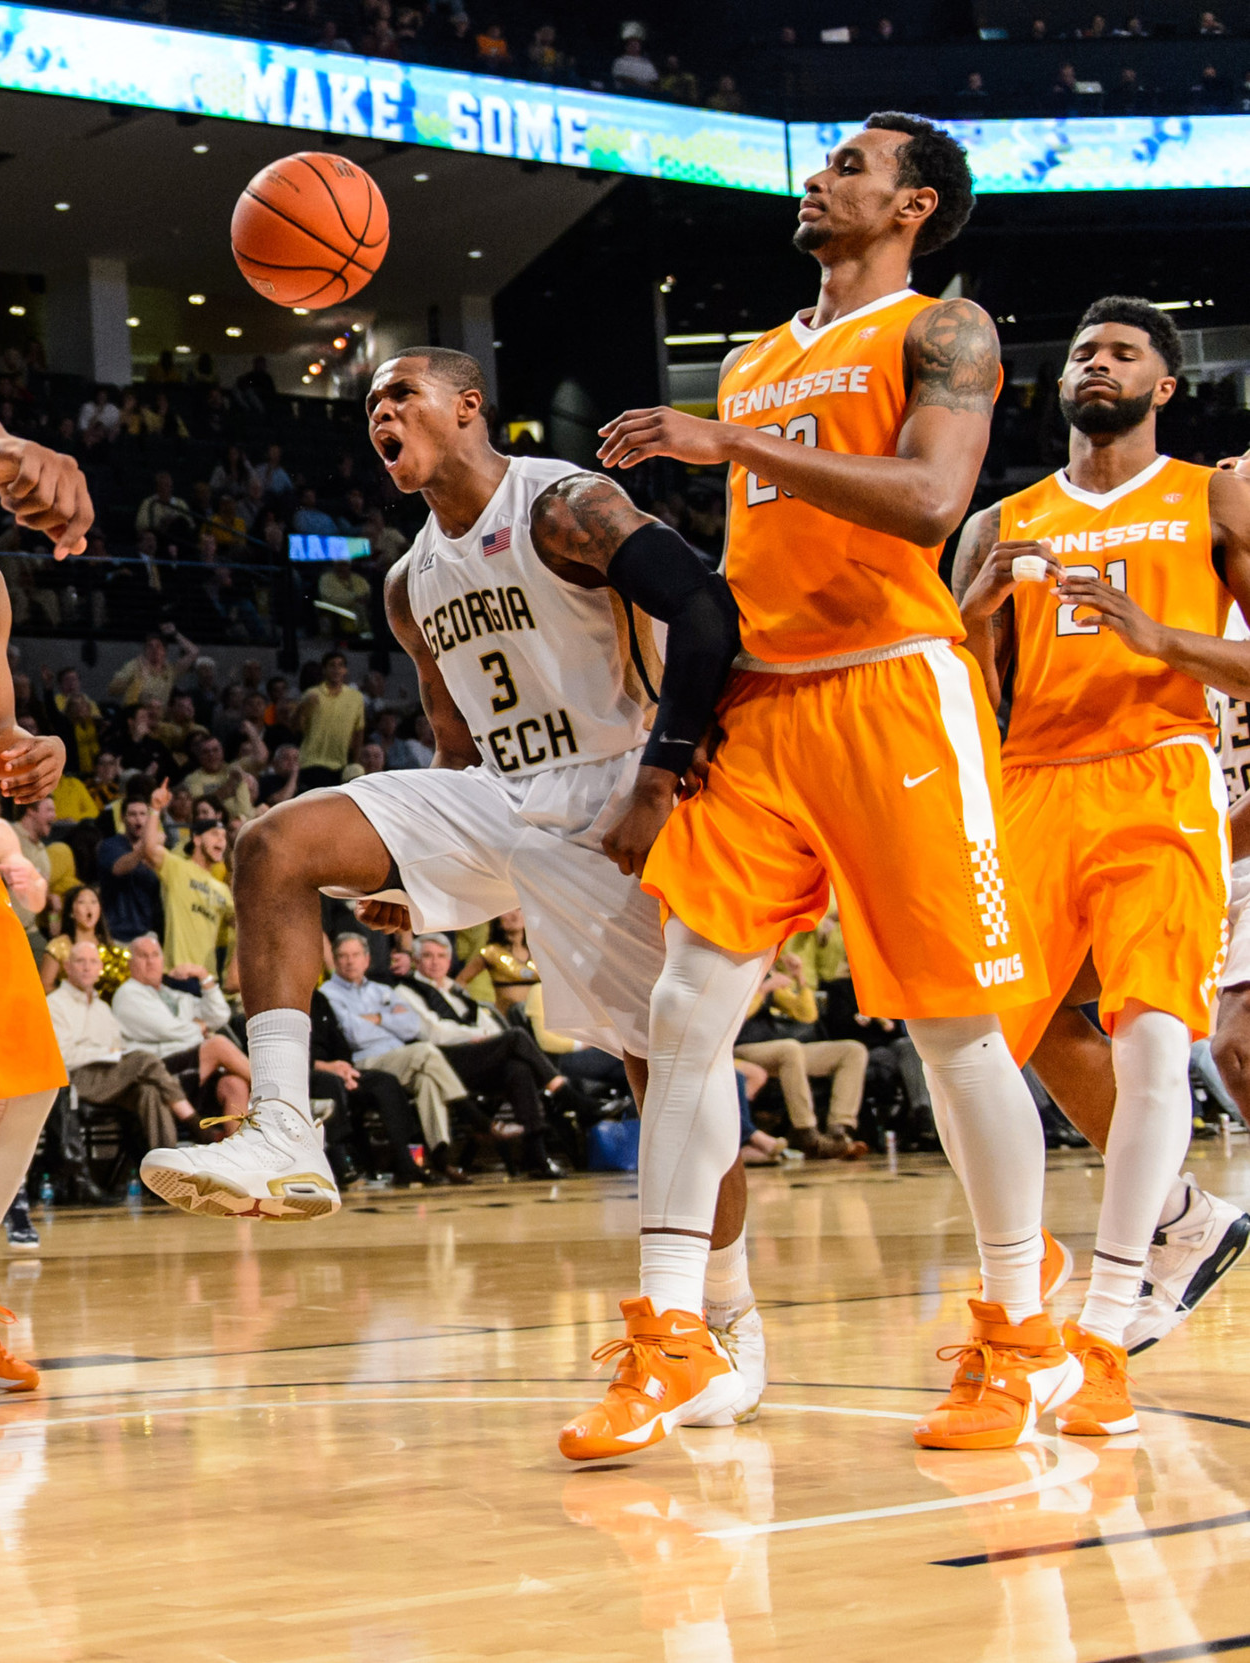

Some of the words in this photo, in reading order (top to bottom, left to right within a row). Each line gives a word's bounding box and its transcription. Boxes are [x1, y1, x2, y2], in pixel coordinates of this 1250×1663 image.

[243, 61, 403, 142] MAKE
[448, 90, 591, 168] SOME
[722, 365, 873, 423] TENNESSEE
[1037, 520, 1190, 553] NNESSEE
[422, 586, 537, 662] GEORGIA
[479, 649, 519, 715] 3
[974, 952, 1025, 988] VOLS
